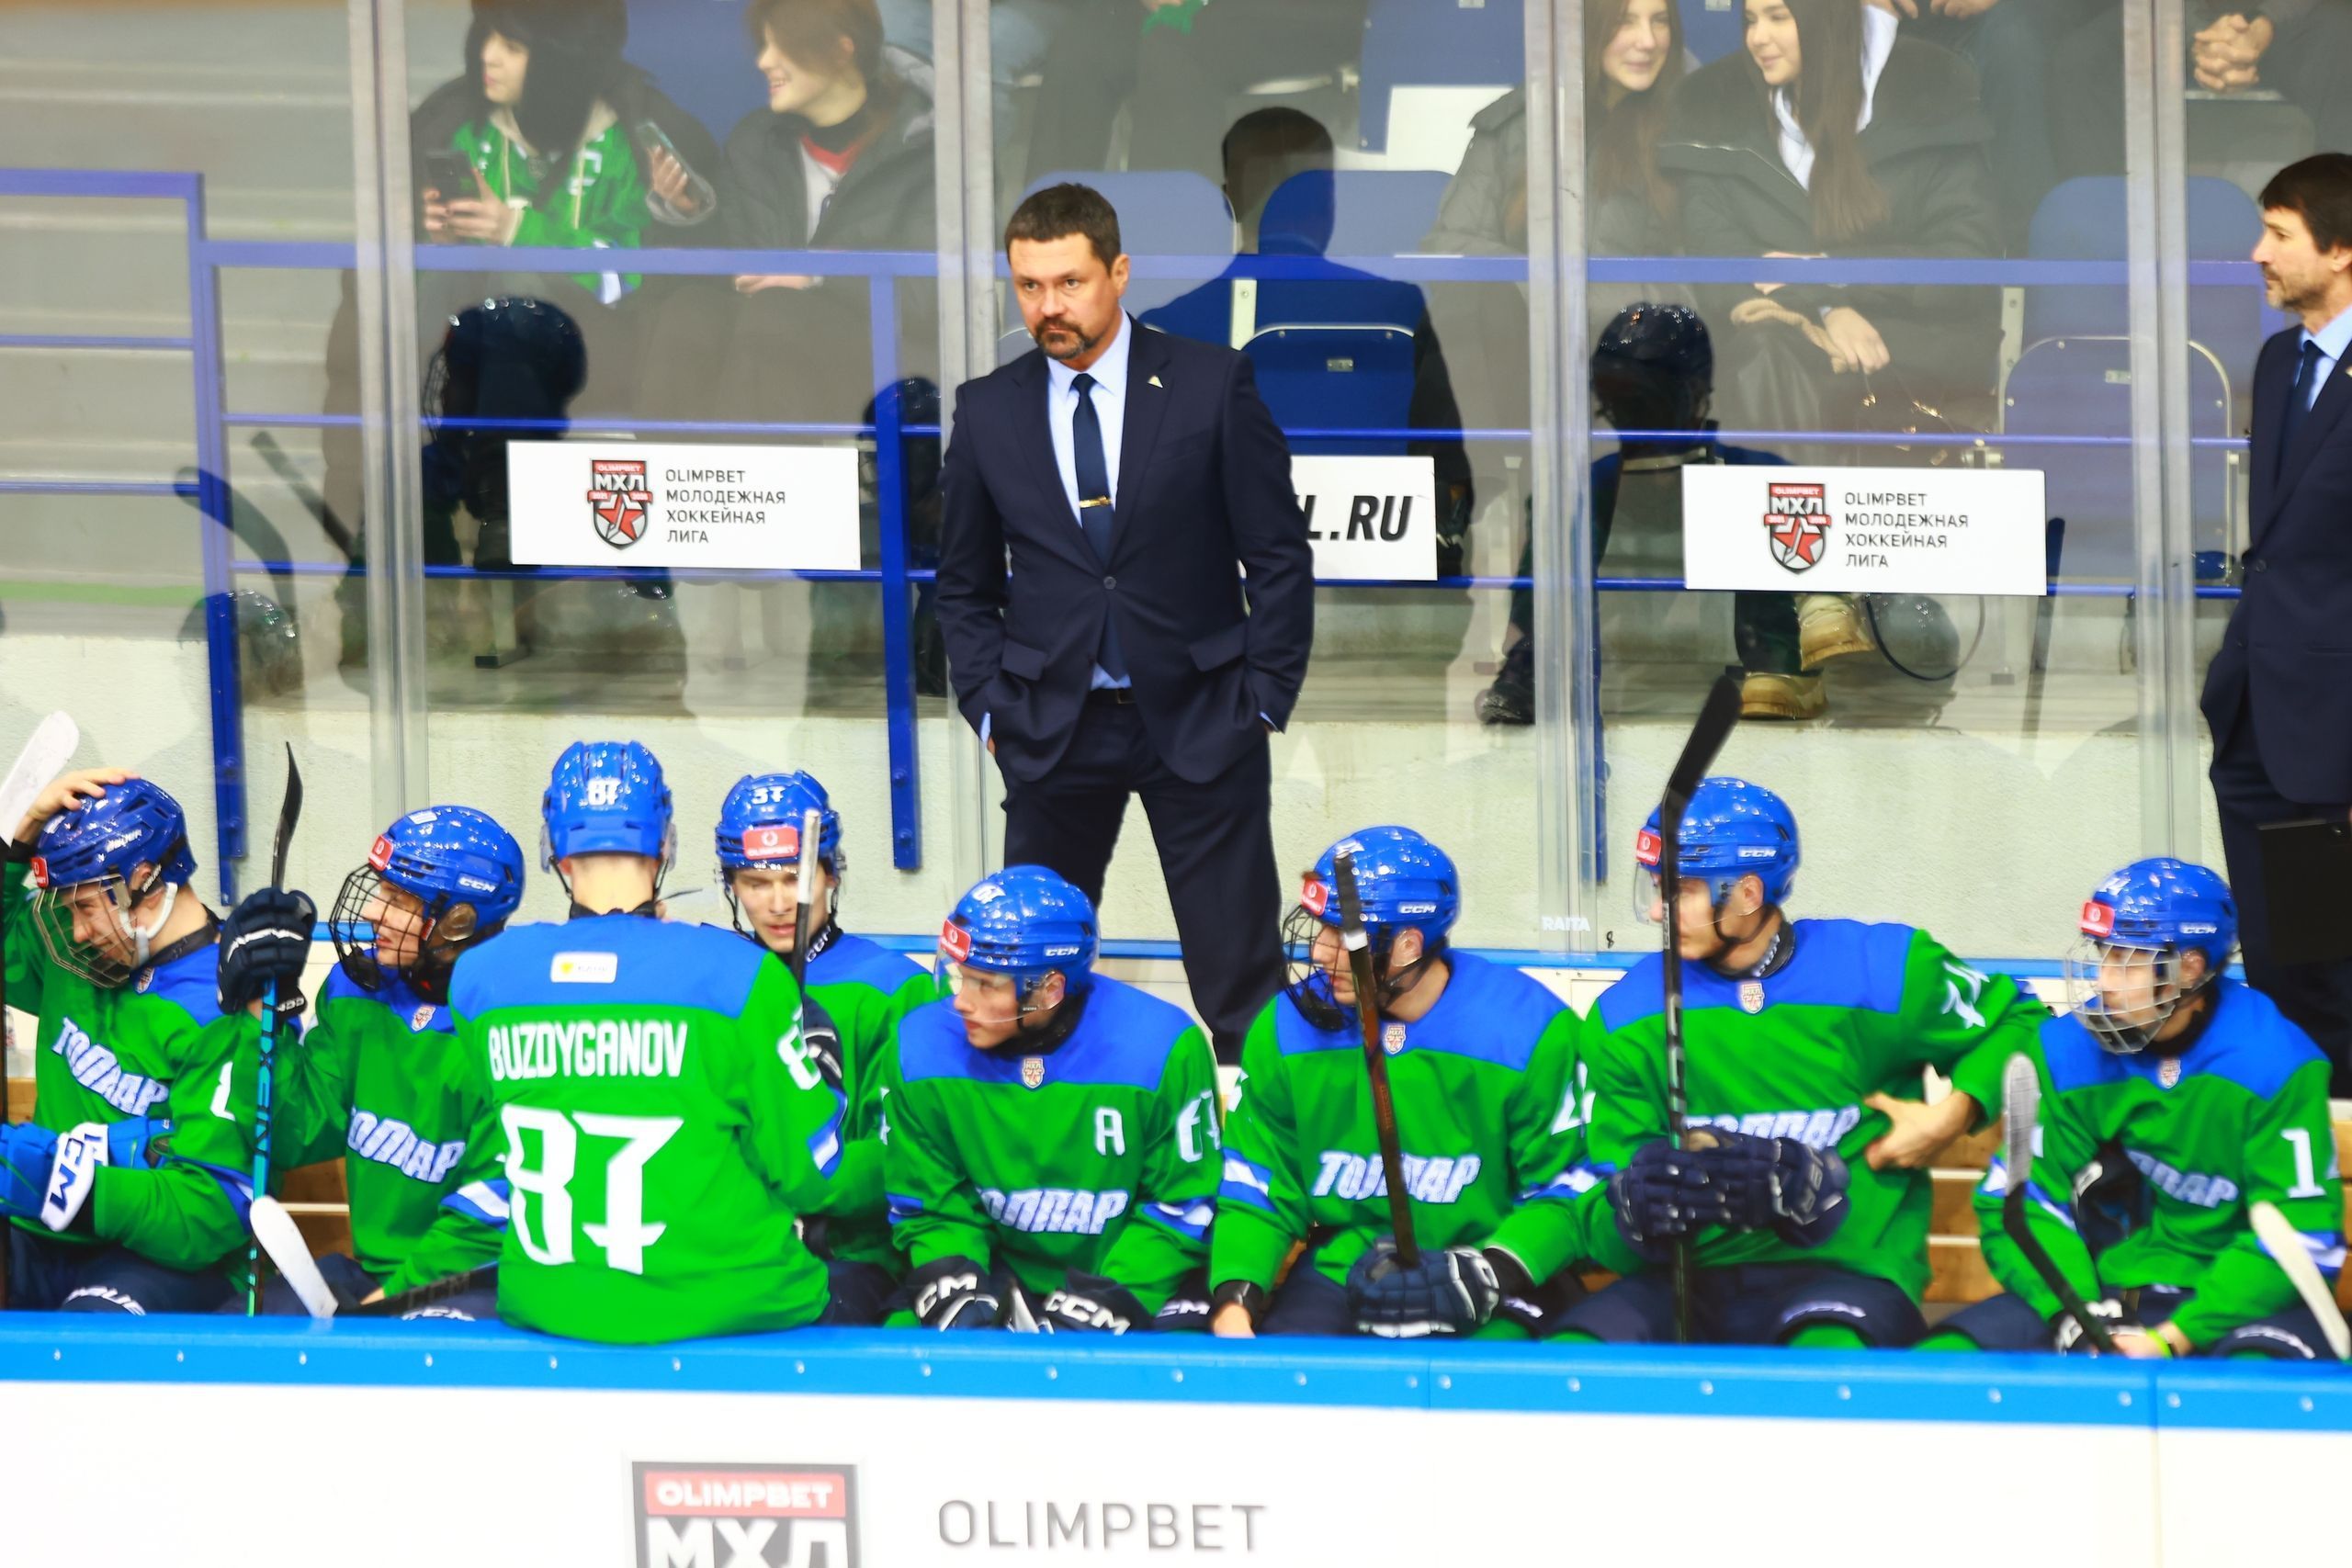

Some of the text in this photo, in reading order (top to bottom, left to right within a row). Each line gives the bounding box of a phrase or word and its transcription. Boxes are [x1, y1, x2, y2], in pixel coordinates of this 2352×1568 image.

[595, 474, 645, 491] МХЛ
[666, 469, 746, 483] OLIMPBET
[667, 490, 786, 505] МОЛОДЕЖНАЯ
[1771, 497, 1823, 514] МХЛ
[1845, 492, 1928, 506] OLIMPBET
[667, 508, 766, 525] ХОККЕЙНАЯ
[1294, 494, 1414, 542] L.RU
[1845, 513, 1969, 528] МОЛОДЕЖНАЯ
[667, 531, 709, 544] ЛИГА
[1845, 530, 1948, 548] ХОККЕЙНАЯ
[1846, 554, 1889, 568] ЛИГА
[588, 778, 622, 807] 87
[1738, 848, 1777, 859] CCM
[458, 875, 497, 893] CCM
[1400, 903, 1437, 914] CCM
[1542, 916, 1591, 931] RAITA
[1045, 947, 1080, 957] CCM
[489, 1020, 688, 1081] BUZDYGANOV
[501, 1103, 685, 1276] 87
[1045, 1290, 1132, 1337] CCM
[655, 1479, 833, 1510] OLIMPBET
[937, 1499, 1269, 1552] OLIMPBET
[647, 1517, 849, 1568] МХЛ
